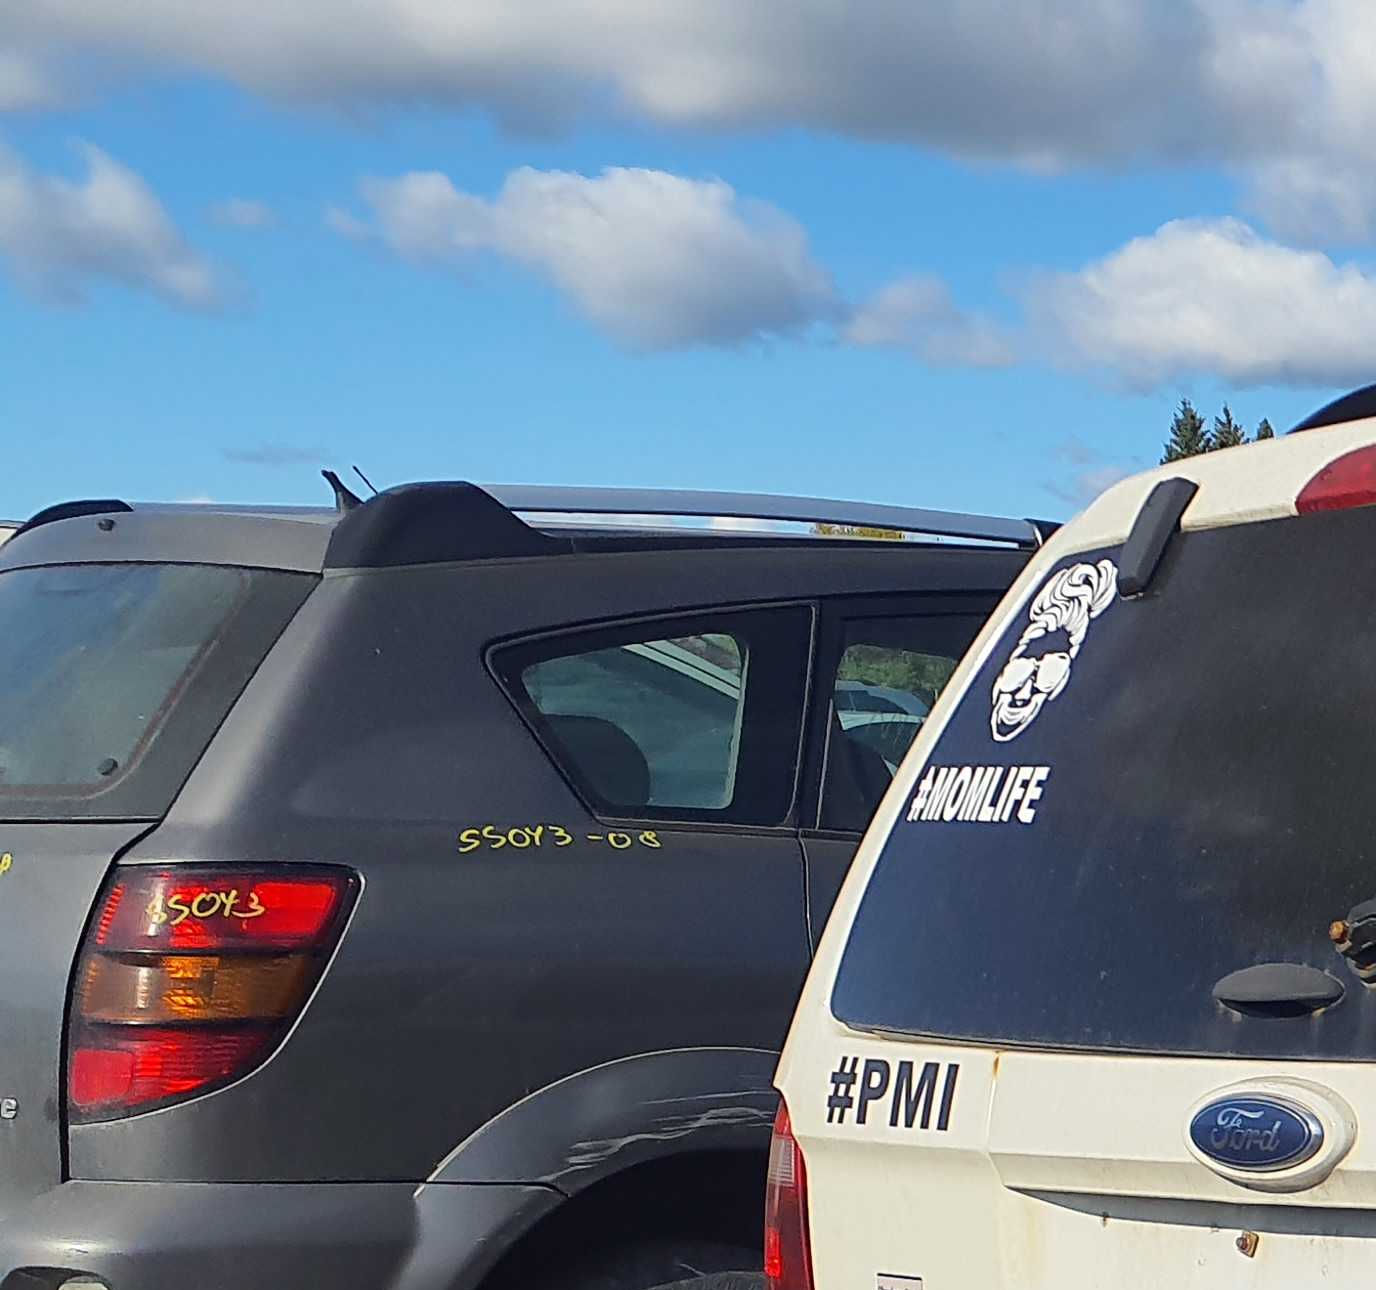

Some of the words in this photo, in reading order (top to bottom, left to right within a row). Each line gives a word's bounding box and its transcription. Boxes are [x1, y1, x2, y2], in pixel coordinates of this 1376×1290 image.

[906, 766, 1051, 824] #MOMLIFE
[826, 1056, 961, 1131] #PMI
[1209, 1106, 1283, 1152] Ford
